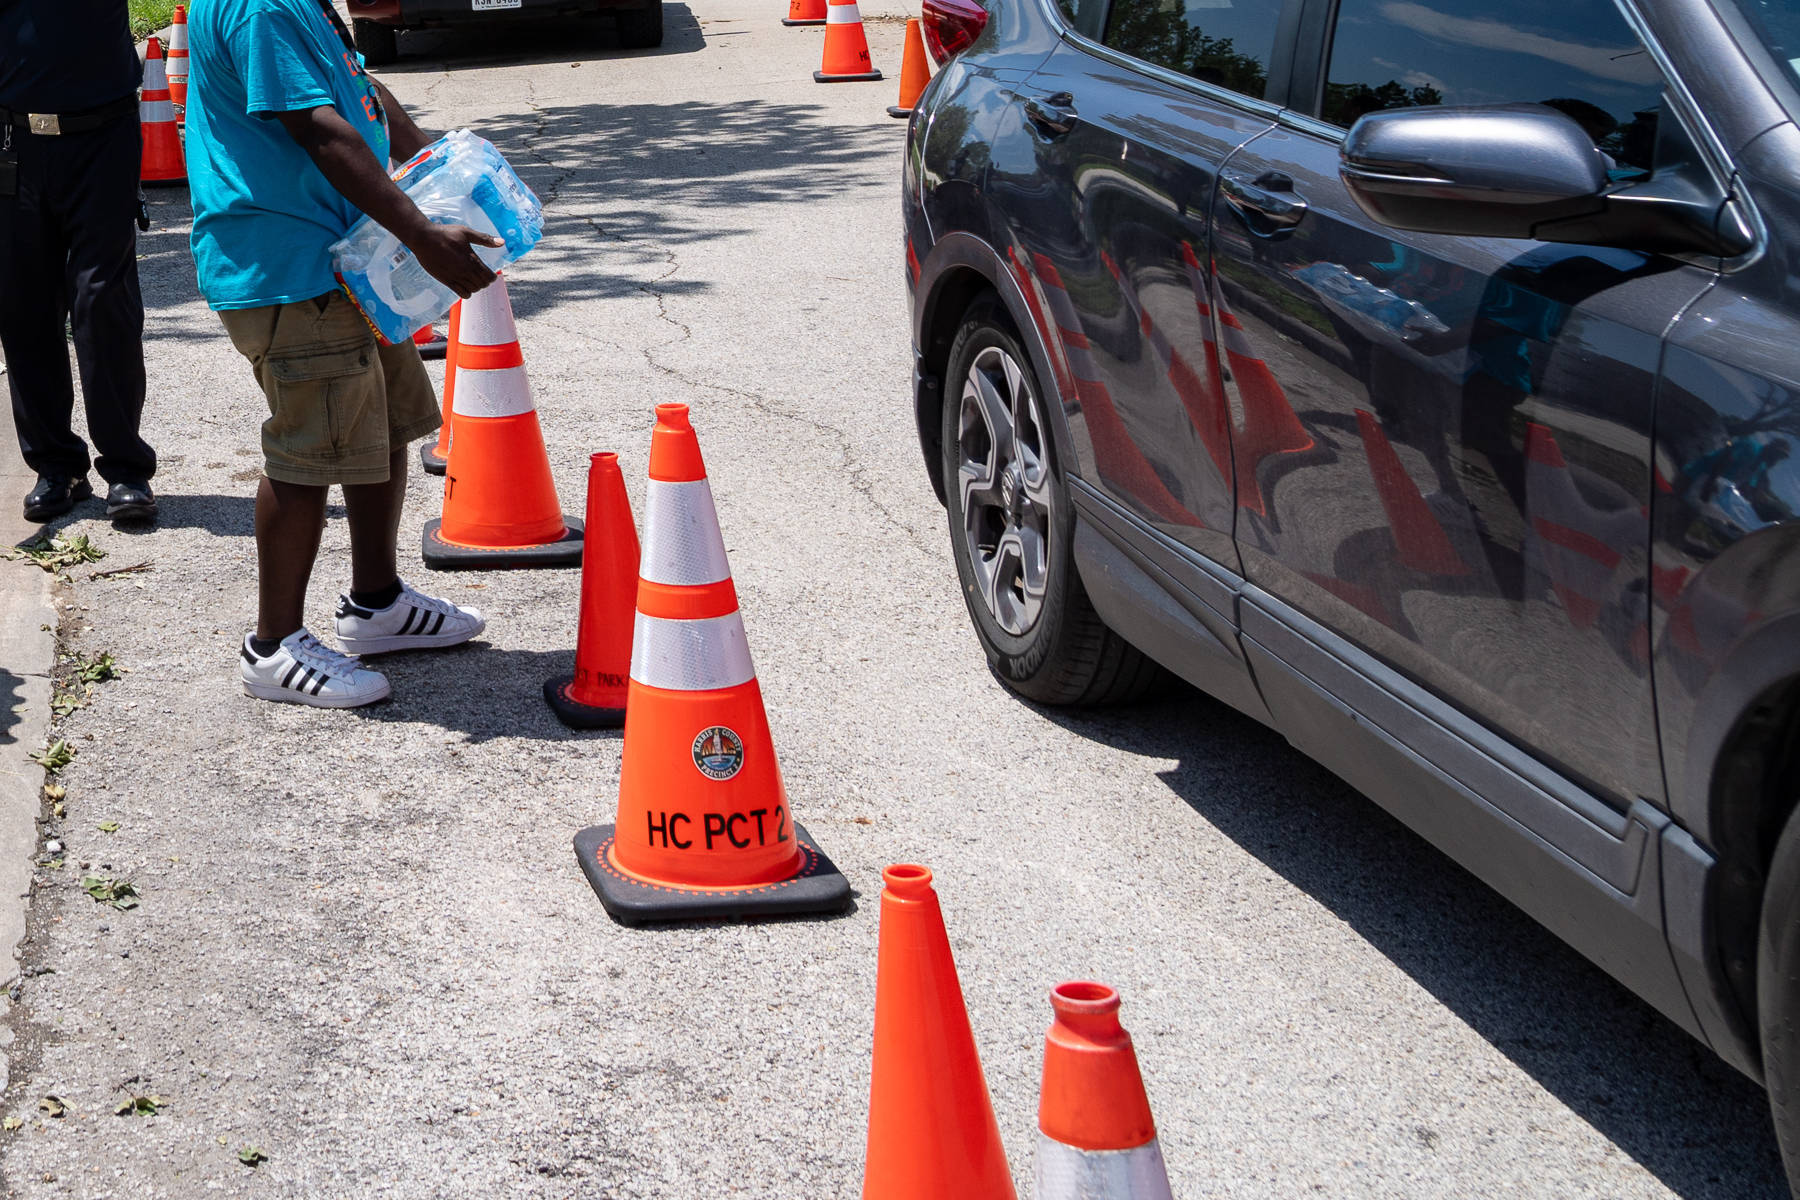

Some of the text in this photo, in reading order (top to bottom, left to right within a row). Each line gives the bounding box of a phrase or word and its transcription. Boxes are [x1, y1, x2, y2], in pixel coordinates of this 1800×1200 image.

[694, 729, 741, 753] HARRIS COUNTY
[701, 765, 734, 778] PRECINCT
[647, 805, 789, 850] HC PCT 2
